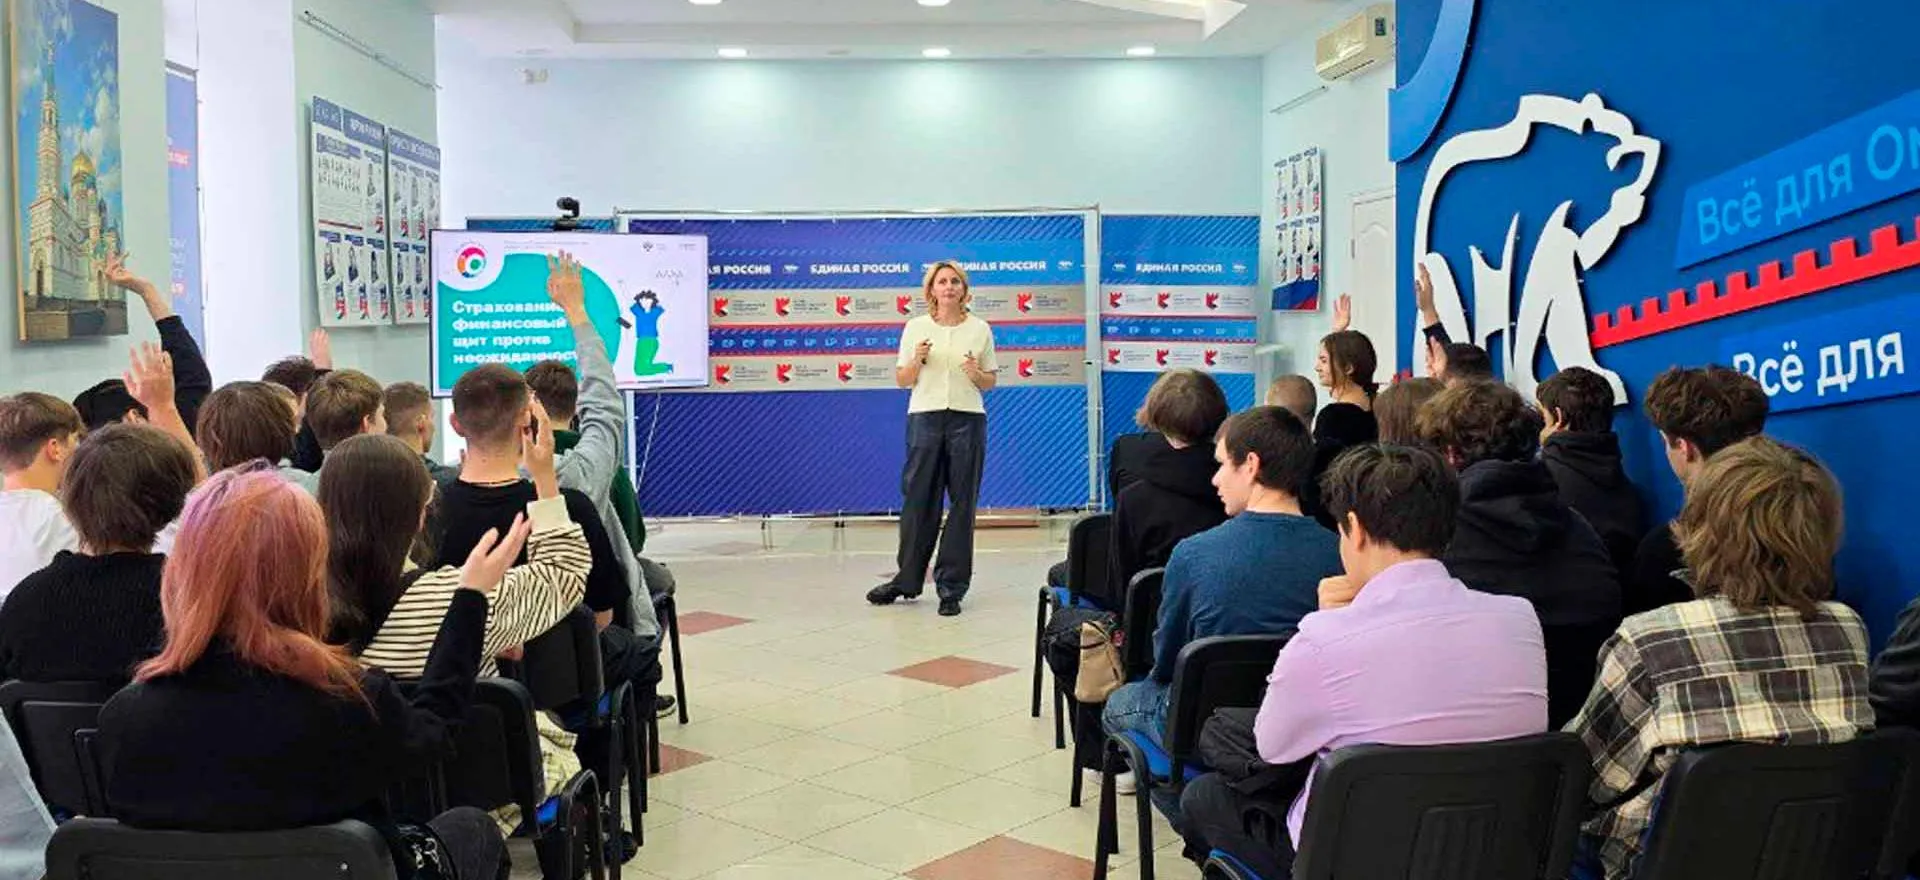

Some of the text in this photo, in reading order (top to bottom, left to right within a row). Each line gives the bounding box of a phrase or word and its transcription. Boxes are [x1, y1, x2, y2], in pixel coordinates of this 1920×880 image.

[1696, 124, 1920, 246] Всё для О
[723, 264, 771, 275] РОССИЯ
[810, 262, 909, 275] ЕДИНАЯ РОССИЯ
[957, 260, 1046, 272] ИНАЯ РОССИЯ
[1136, 263, 1223, 274] ЕДИНАЯ РОССИЯ
[452, 317, 567, 333] финансовый
[452, 335, 551, 349] щит против
[1732, 331, 1905, 397] Всё для
